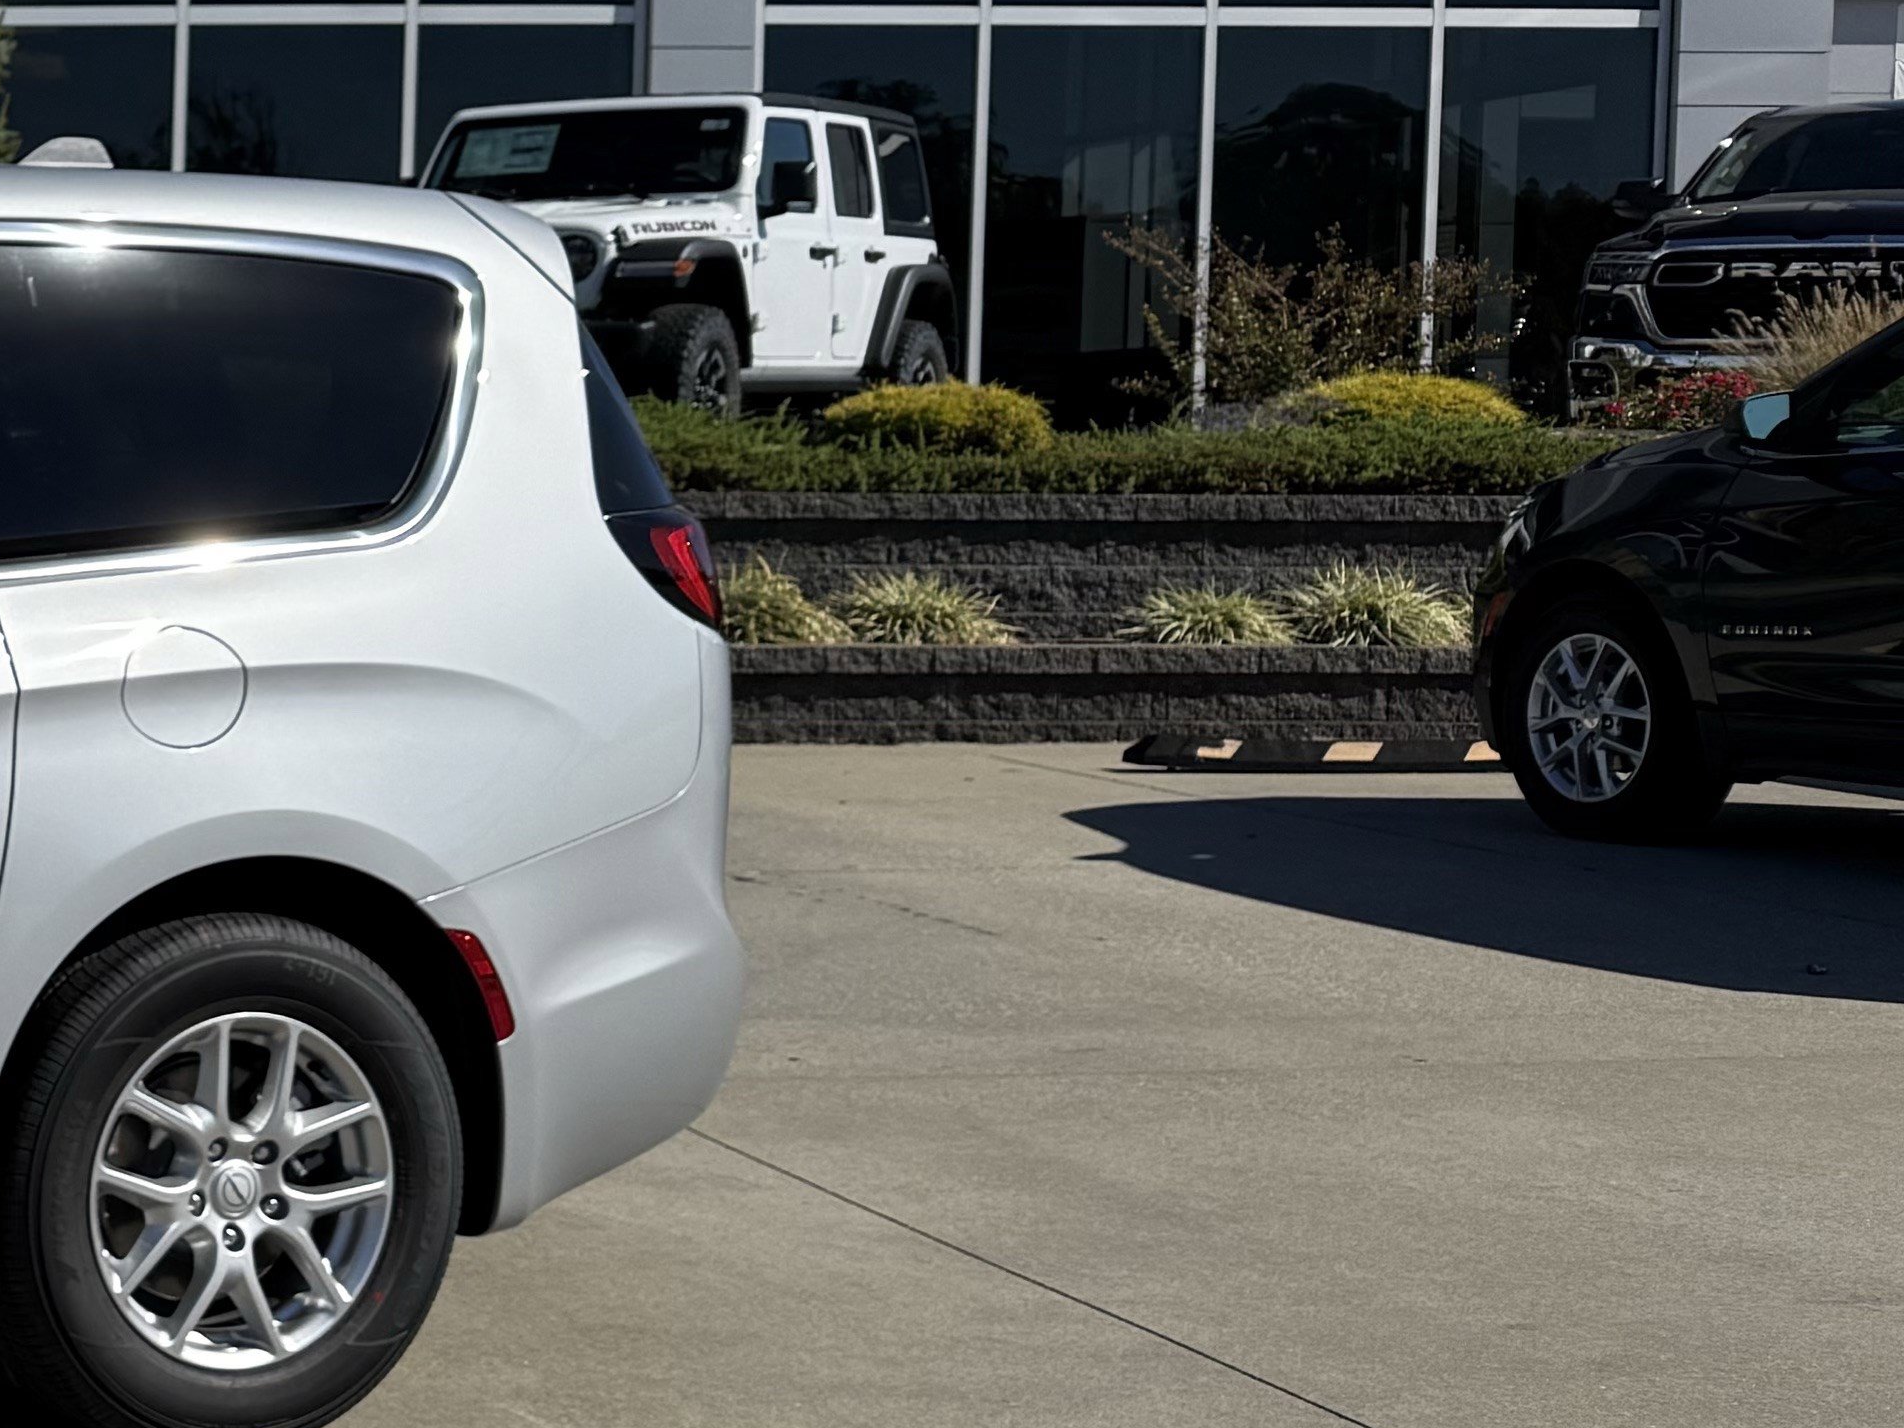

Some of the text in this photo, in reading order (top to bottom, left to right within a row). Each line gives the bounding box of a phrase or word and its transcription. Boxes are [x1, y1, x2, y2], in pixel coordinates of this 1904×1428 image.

[631, 220, 717, 234] RUBICON
[1730, 261, 1883, 278] RAM
[1722, 624, 1813, 636] EQUINOX
